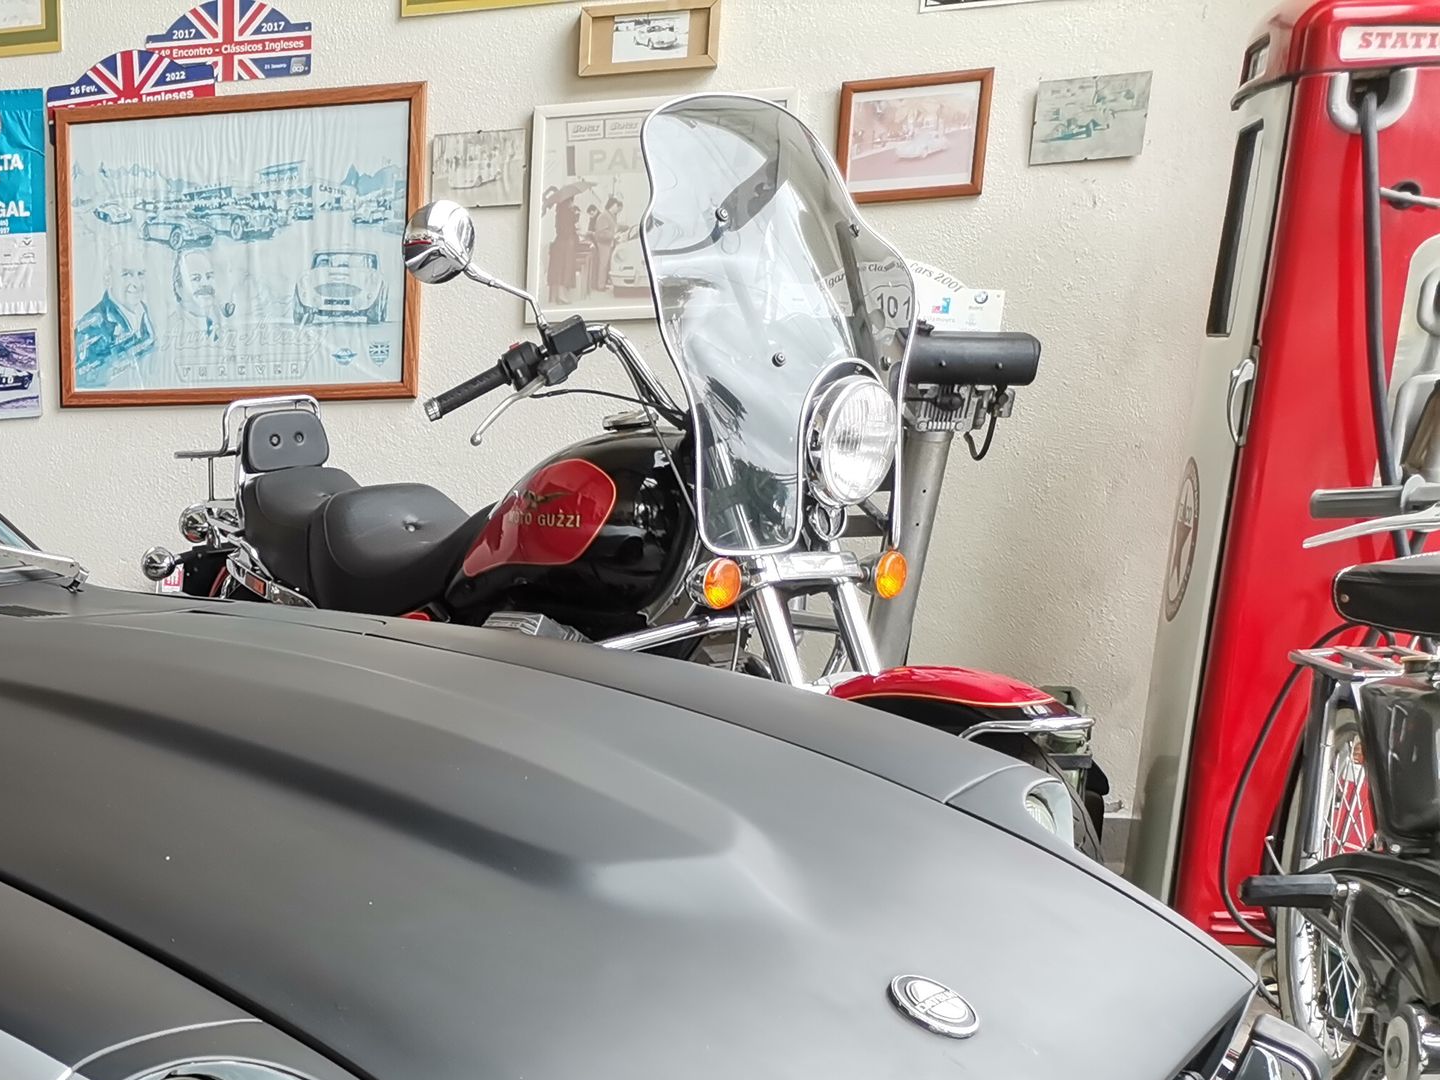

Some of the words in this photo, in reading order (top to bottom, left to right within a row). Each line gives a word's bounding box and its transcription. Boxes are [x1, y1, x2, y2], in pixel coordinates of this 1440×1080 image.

[261, 22, 285, 32] 2017
[172, 29, 196, 39] 2017
[1358, 31, 1440, 49] STATI
[172, 46, 214, 58] Encontro
[221, 41, 263, 55] Clássicos
[264, 38, 305, 53] Ingleses
[165, 71, 186, 81] 2022
[70, 86, 81, 96] 26
[81, 85, 98, 95] Fev.
[934, 271, 964, 293] 2001
[537, 513, 581, 528] GUZZI
